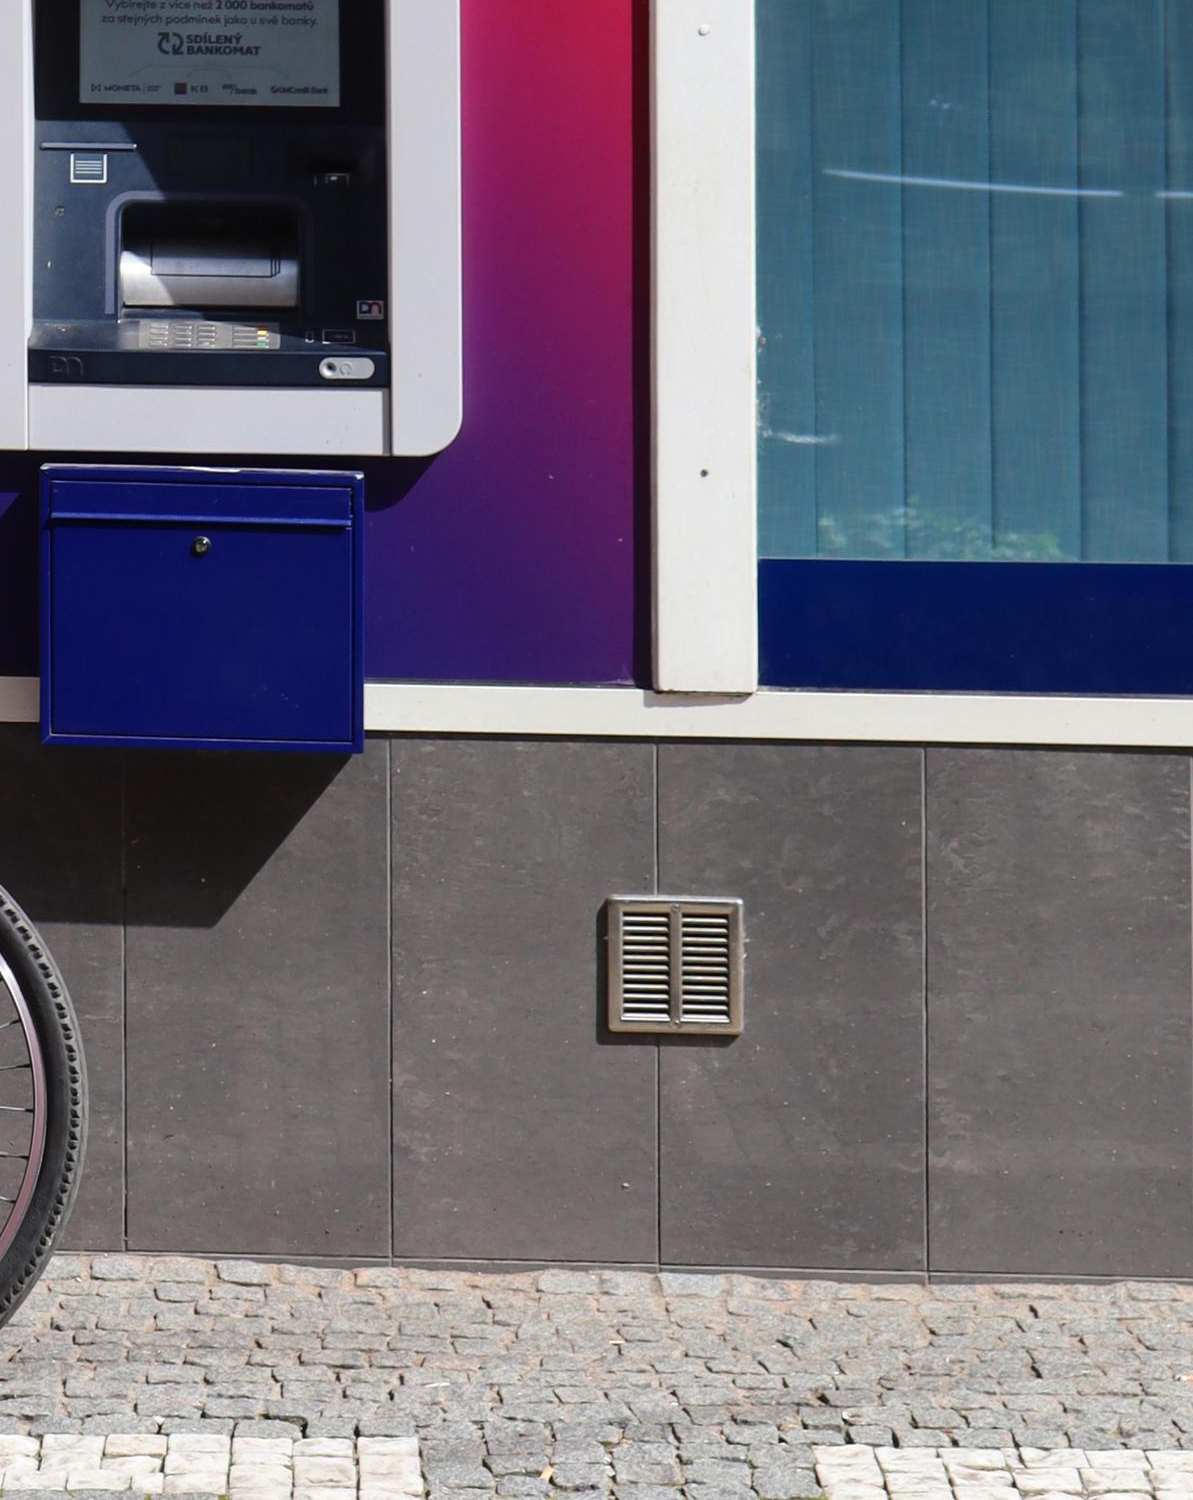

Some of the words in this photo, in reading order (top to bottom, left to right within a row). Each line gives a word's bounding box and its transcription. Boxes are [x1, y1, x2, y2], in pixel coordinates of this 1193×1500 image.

[159, 1, 167, 9] z
[168, 0, 191, 10] více
[193, 0, 214, 10] než
[249, 0, 314, 11] bankomatů
[101, 14, 115, 23] za
[117, 13, 162, 26] stejných
[164, 14, 222, 27] podmínek
[223, 14, 248, 27] jako
[250, 17, 257, 25] u
[259, 15, 279, 25] své
[186, 32, 243, 45] SDÍLENÝ
[186, 45, 262, 56] BANKOMAT
[104, 84, 141, 92] MONETA
